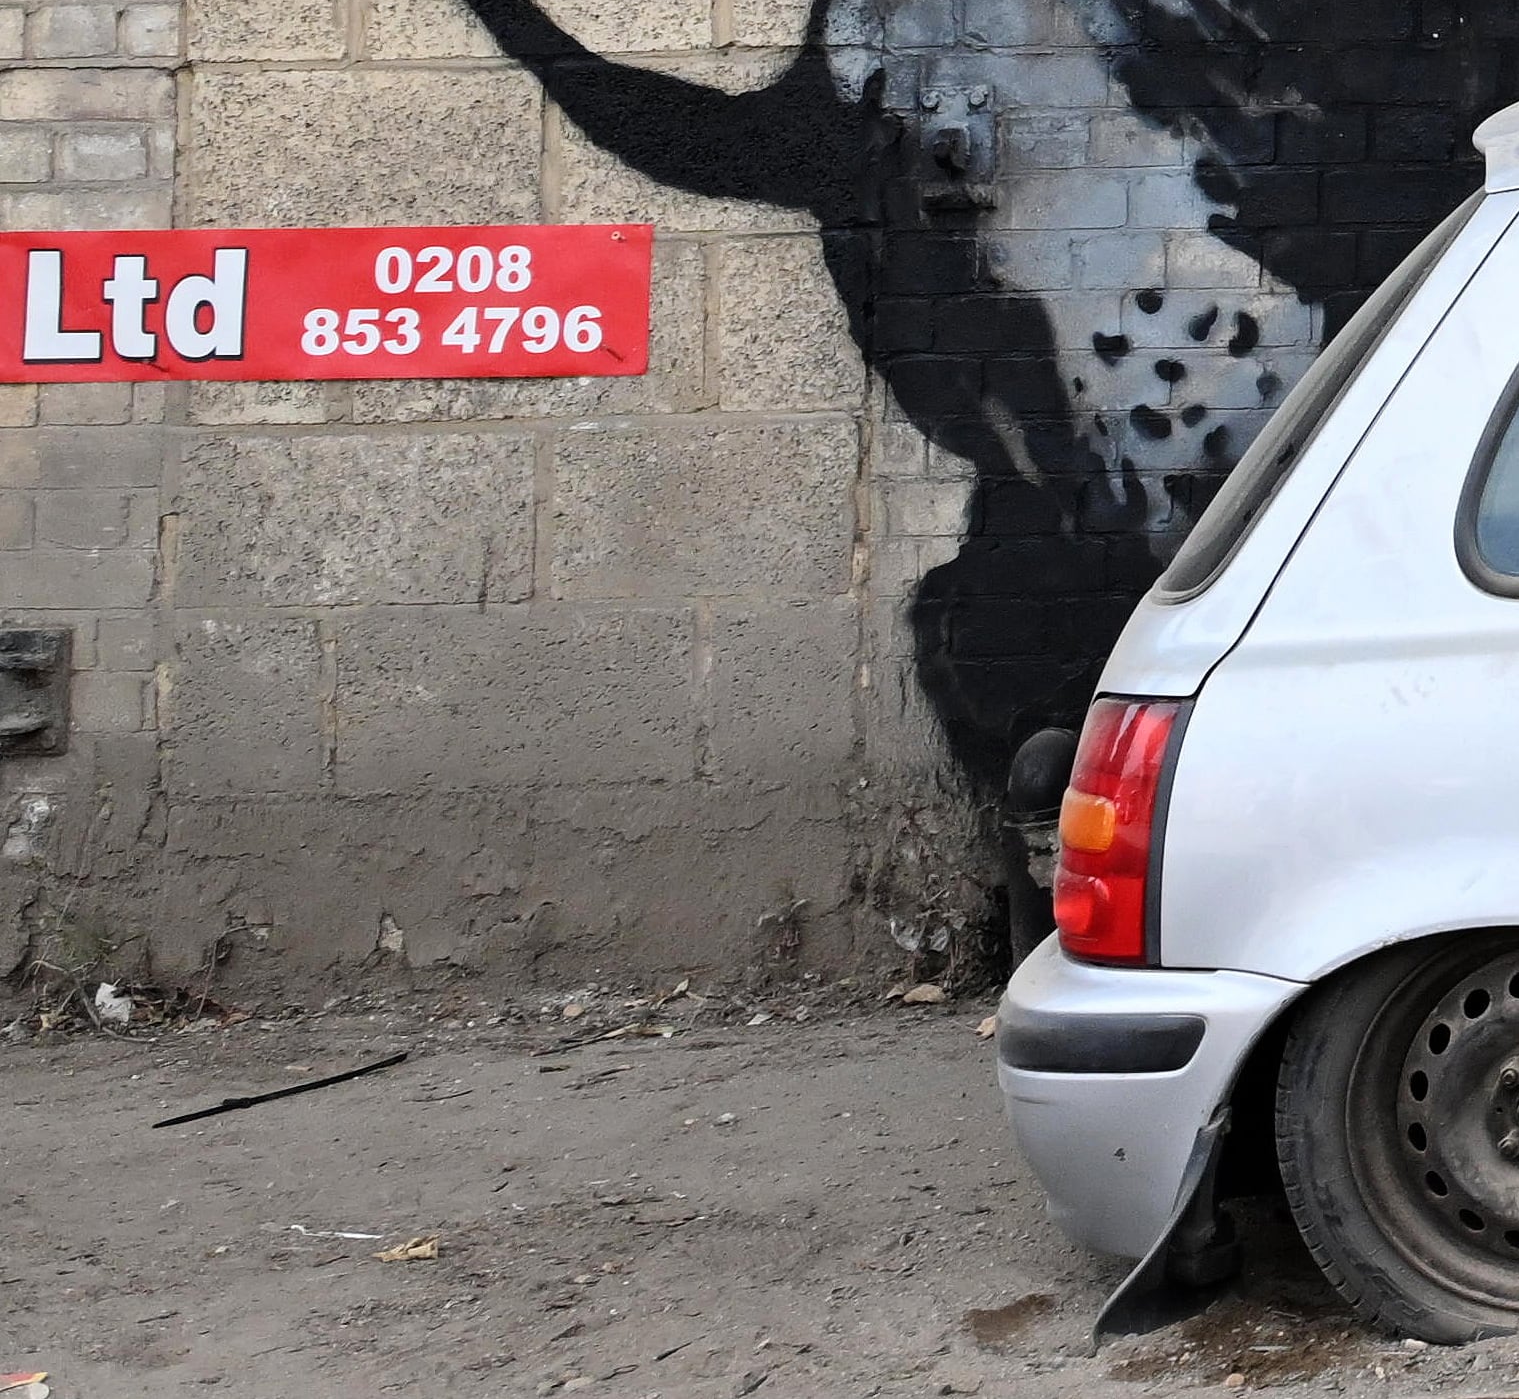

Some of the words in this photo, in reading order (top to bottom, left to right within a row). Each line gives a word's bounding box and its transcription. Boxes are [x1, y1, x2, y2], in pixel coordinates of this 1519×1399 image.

[374, 245, 532, 294] 0208
[23, 248, 249, 362] Ltd
[301, 308, 421, 356] 853
[442, 305, 603, 354] 4796
